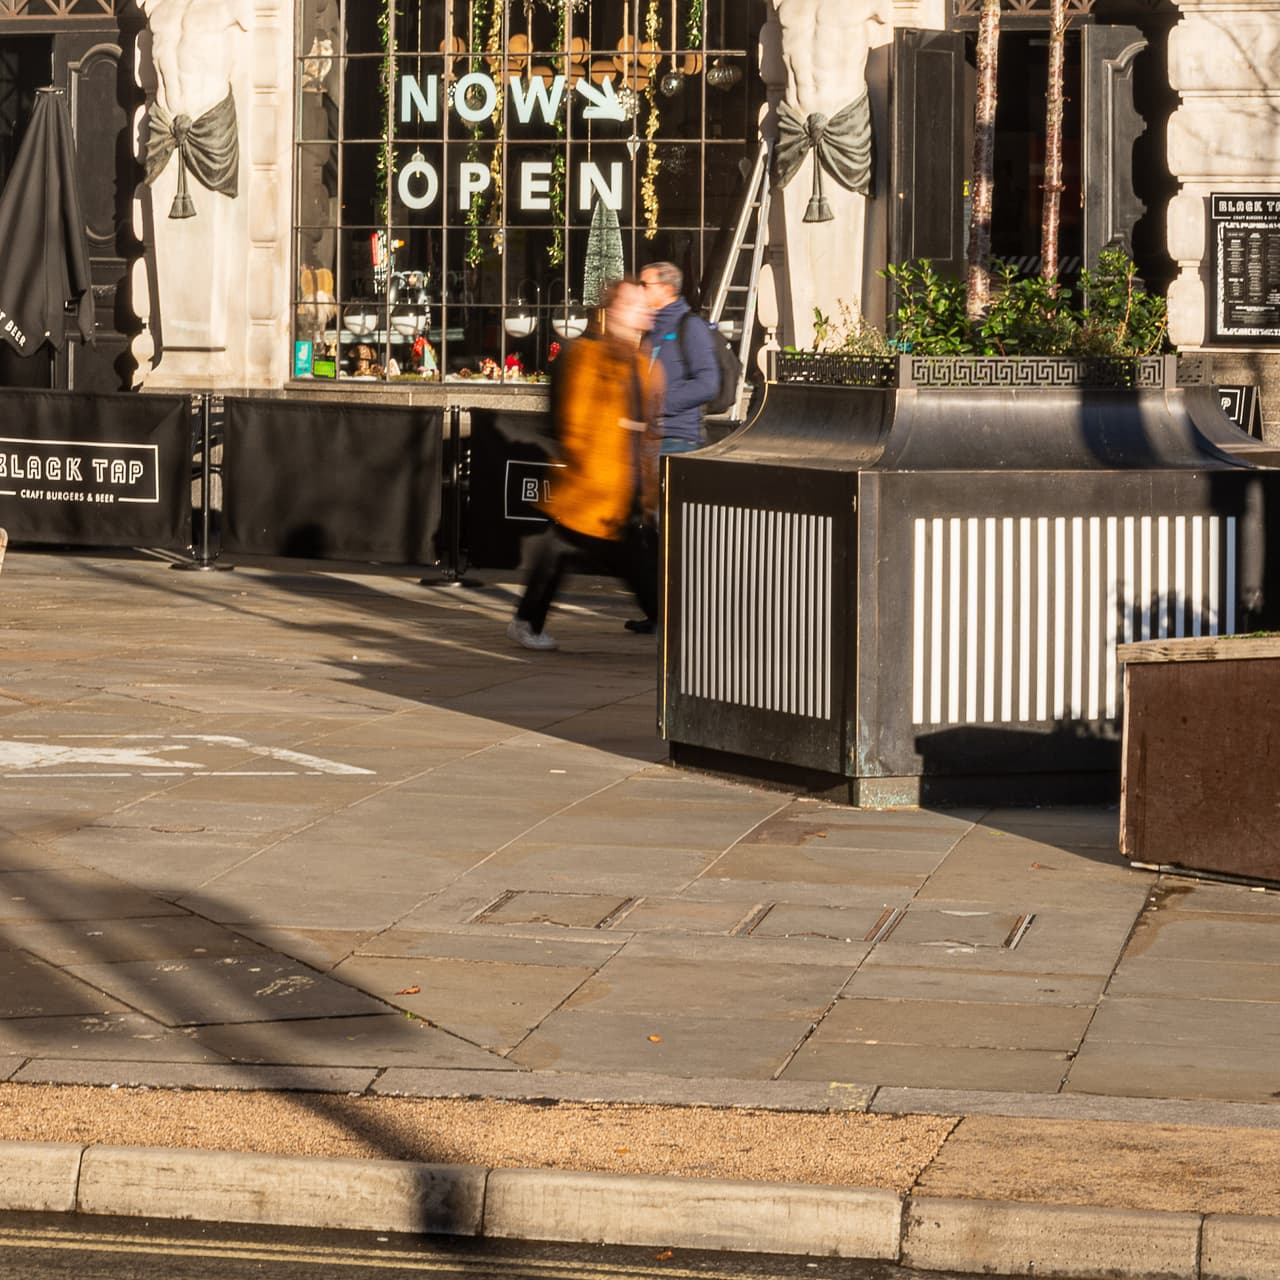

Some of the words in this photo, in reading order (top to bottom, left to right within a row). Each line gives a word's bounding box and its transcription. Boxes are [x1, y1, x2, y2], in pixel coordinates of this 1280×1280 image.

[400, 73, 566, 124] NOW
[397, 160, 624, 211] OPEN
[1218, 200, 1263, 212] BLACK
[4, 320, 26, 347] BEER
[92, 458, 144, 484] TAP
[20, 489, 44, 500] CRAFT
[46, 490, 84, 502] BURGERS
[87, 492, 93, 502] &
[95, 493, 114, 503] BEER
